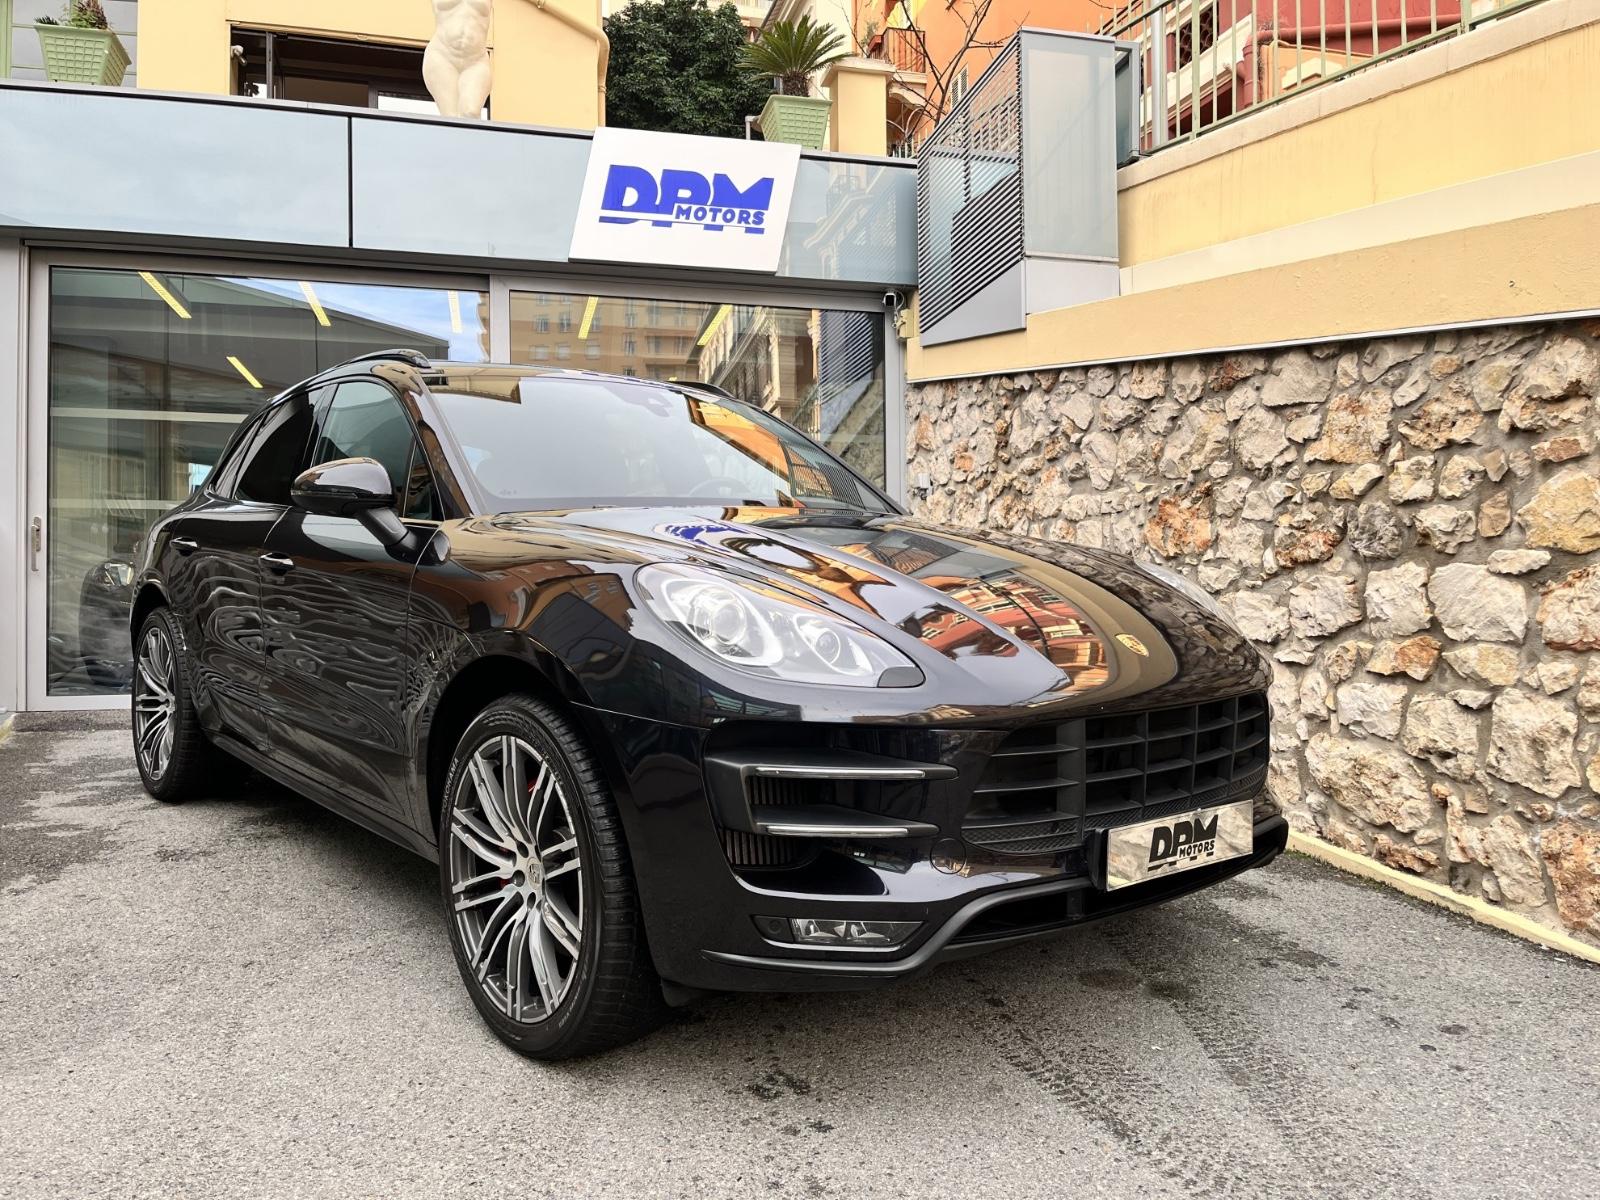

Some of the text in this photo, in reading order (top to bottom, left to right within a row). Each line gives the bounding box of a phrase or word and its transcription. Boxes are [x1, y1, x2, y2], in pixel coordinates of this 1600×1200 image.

[599, 164, 775, 234] DPM
[675, 206, 765, 225] MOTORS
[1148, 814, 1219, 872] DPM
[1179, 841, 1214, 858] MOTORS
